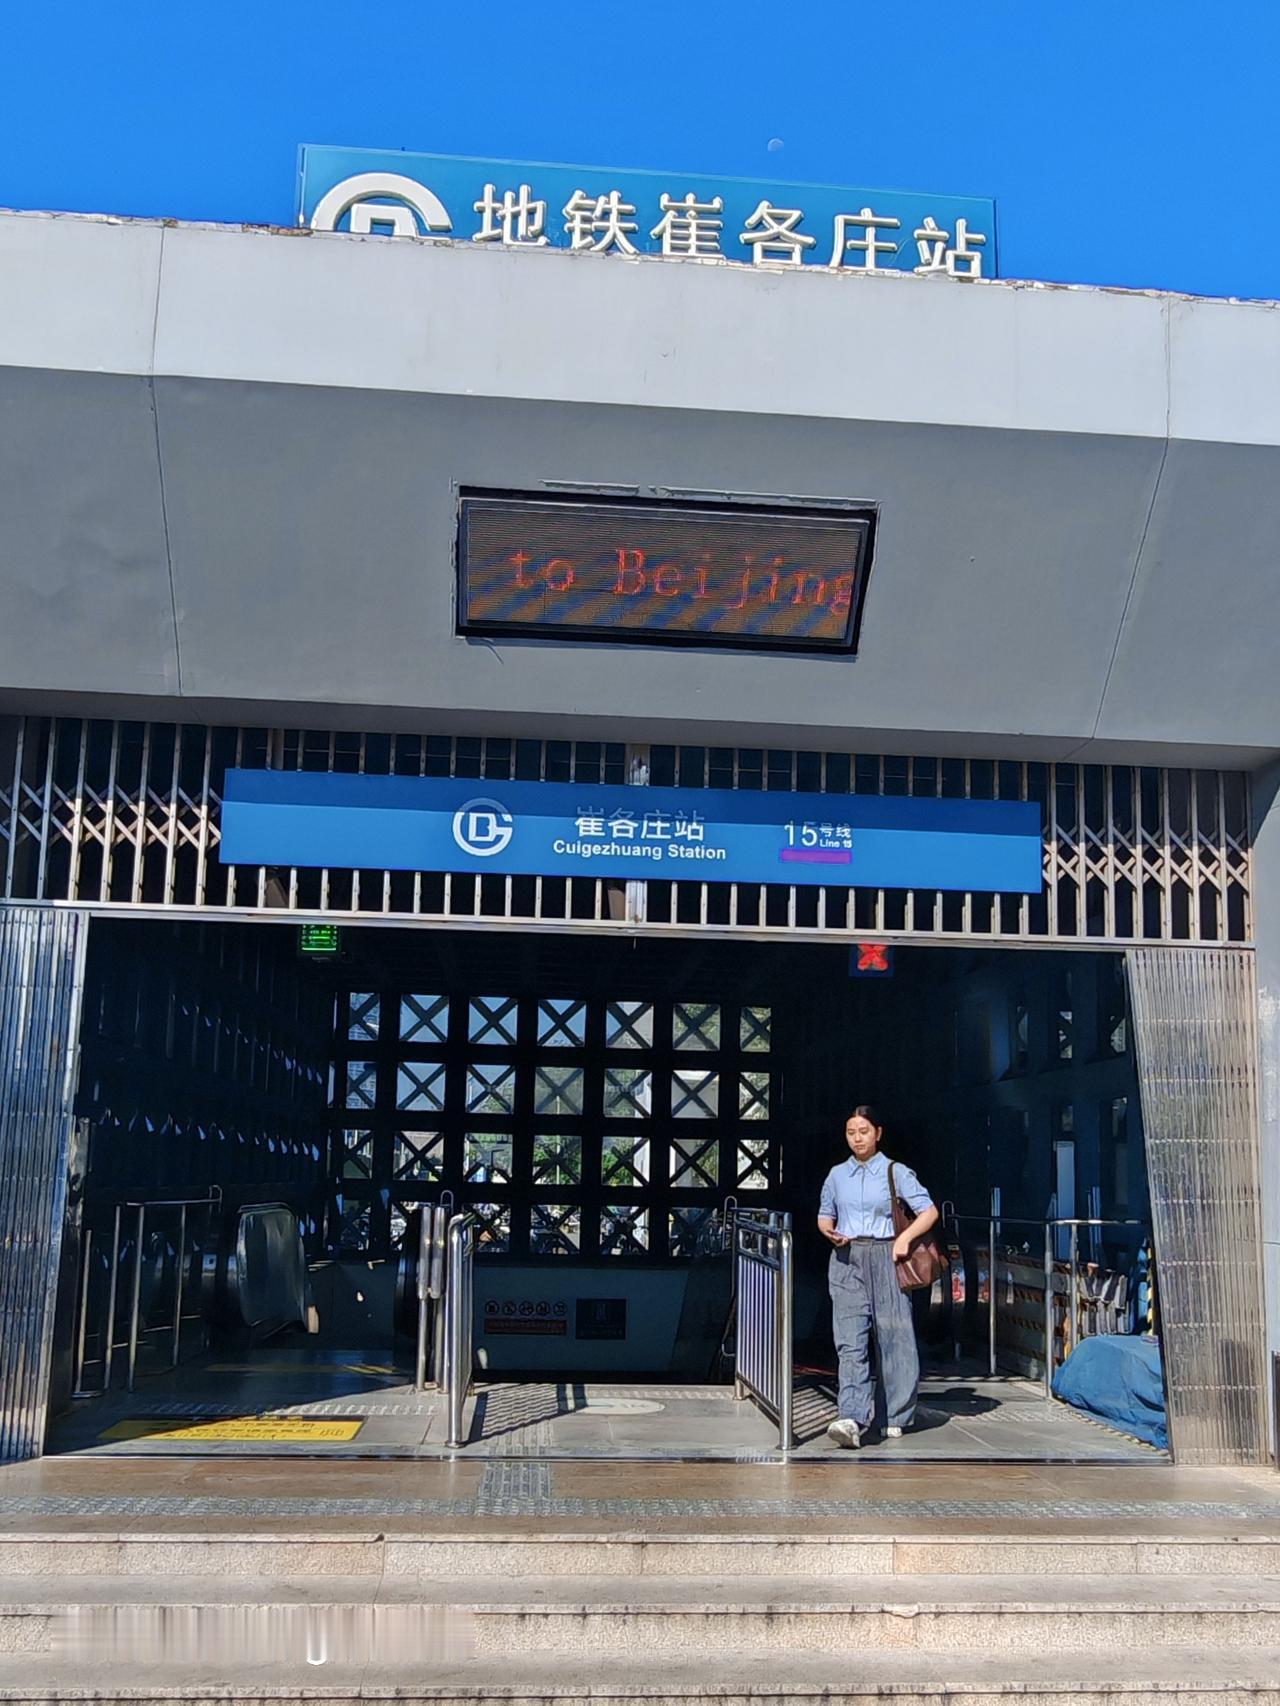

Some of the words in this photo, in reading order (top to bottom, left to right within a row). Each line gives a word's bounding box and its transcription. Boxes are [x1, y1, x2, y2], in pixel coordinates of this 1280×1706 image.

[473, 184, 986, 280] 地铁崔各庄站
[509, 550, 575, 592] to
[575, 807, 704, 841] 崔各庄站
[552, 840, 661, 861] Cuigezhuang
[667, 845, 727, 861] Station
[819, 838, 840, 849] Line
